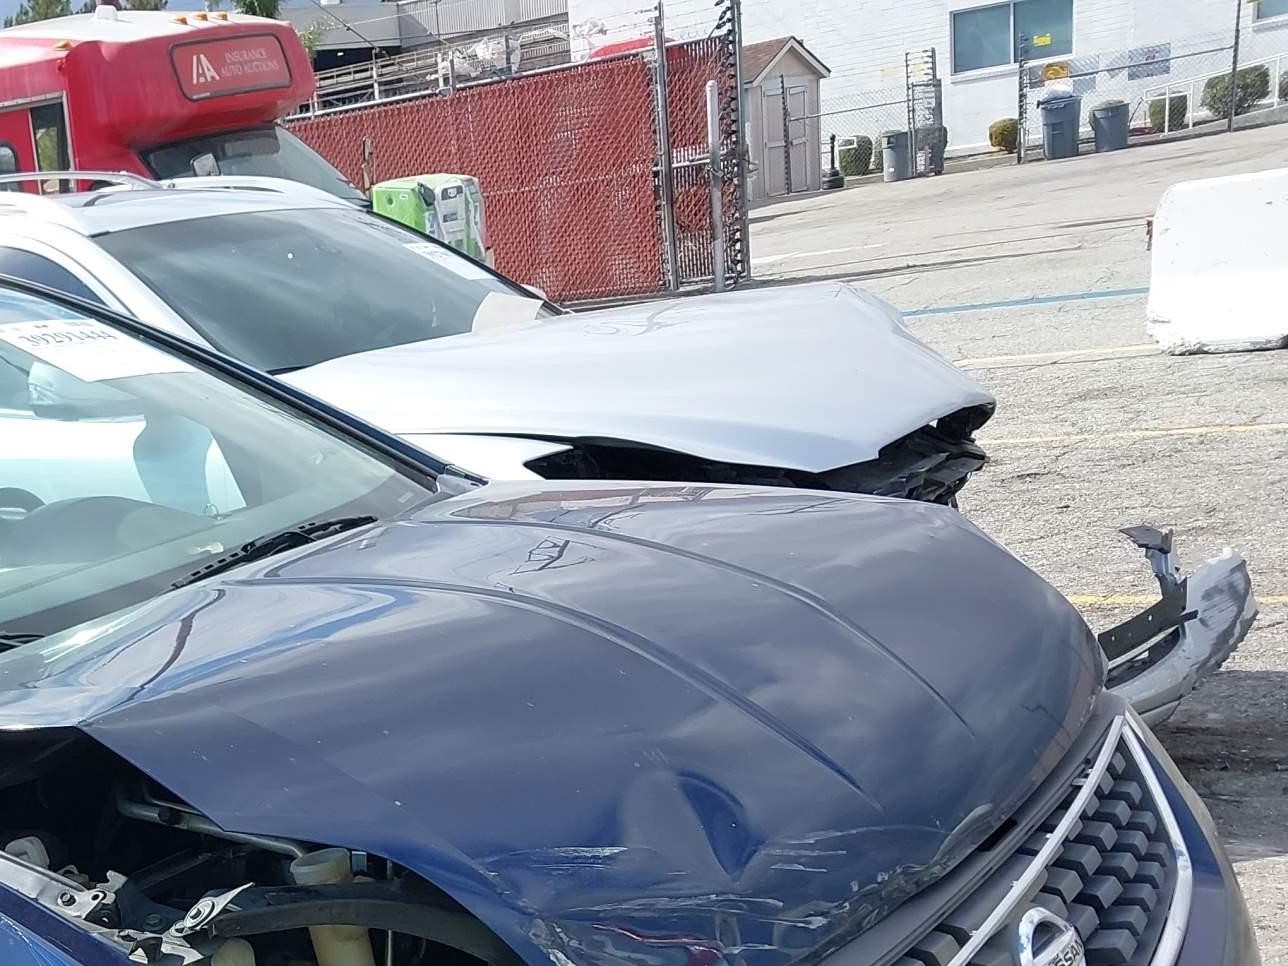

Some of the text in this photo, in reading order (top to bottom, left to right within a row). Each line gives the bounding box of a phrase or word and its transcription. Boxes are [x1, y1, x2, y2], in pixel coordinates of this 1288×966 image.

[224, 48, 267, 64] INSURANCE
[220, 60, 280, 77] AUTO AUCTIONS
[18, 330, 118, 347] 39291444
